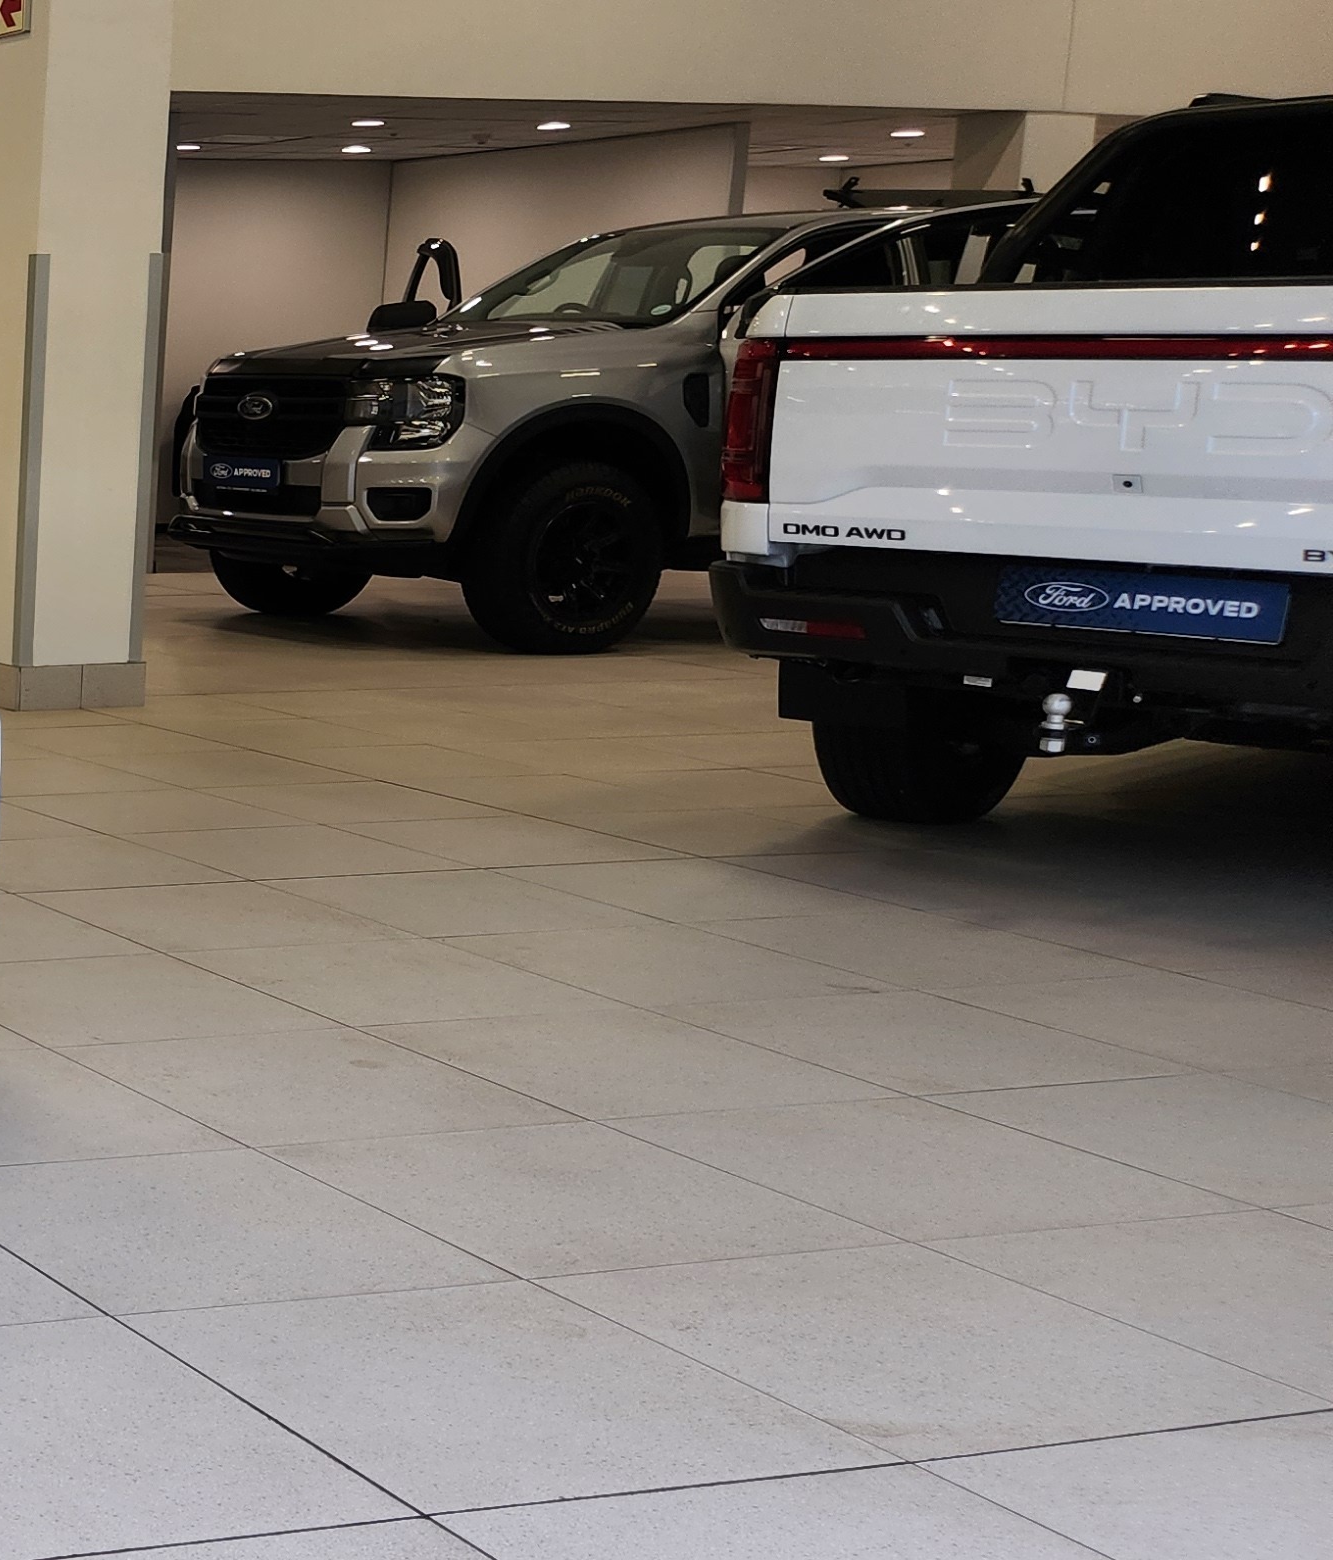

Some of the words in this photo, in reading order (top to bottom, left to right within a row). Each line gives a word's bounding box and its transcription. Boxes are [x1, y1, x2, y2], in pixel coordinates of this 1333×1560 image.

[233, 467, 271, 478] APPROVED
[783, 523, 839, 537] DMO
[845, 527, 906, 541] AWD
[1038, 584, 1097, 609] Ford
[1113, 592, 1261, 619] APPROVED
